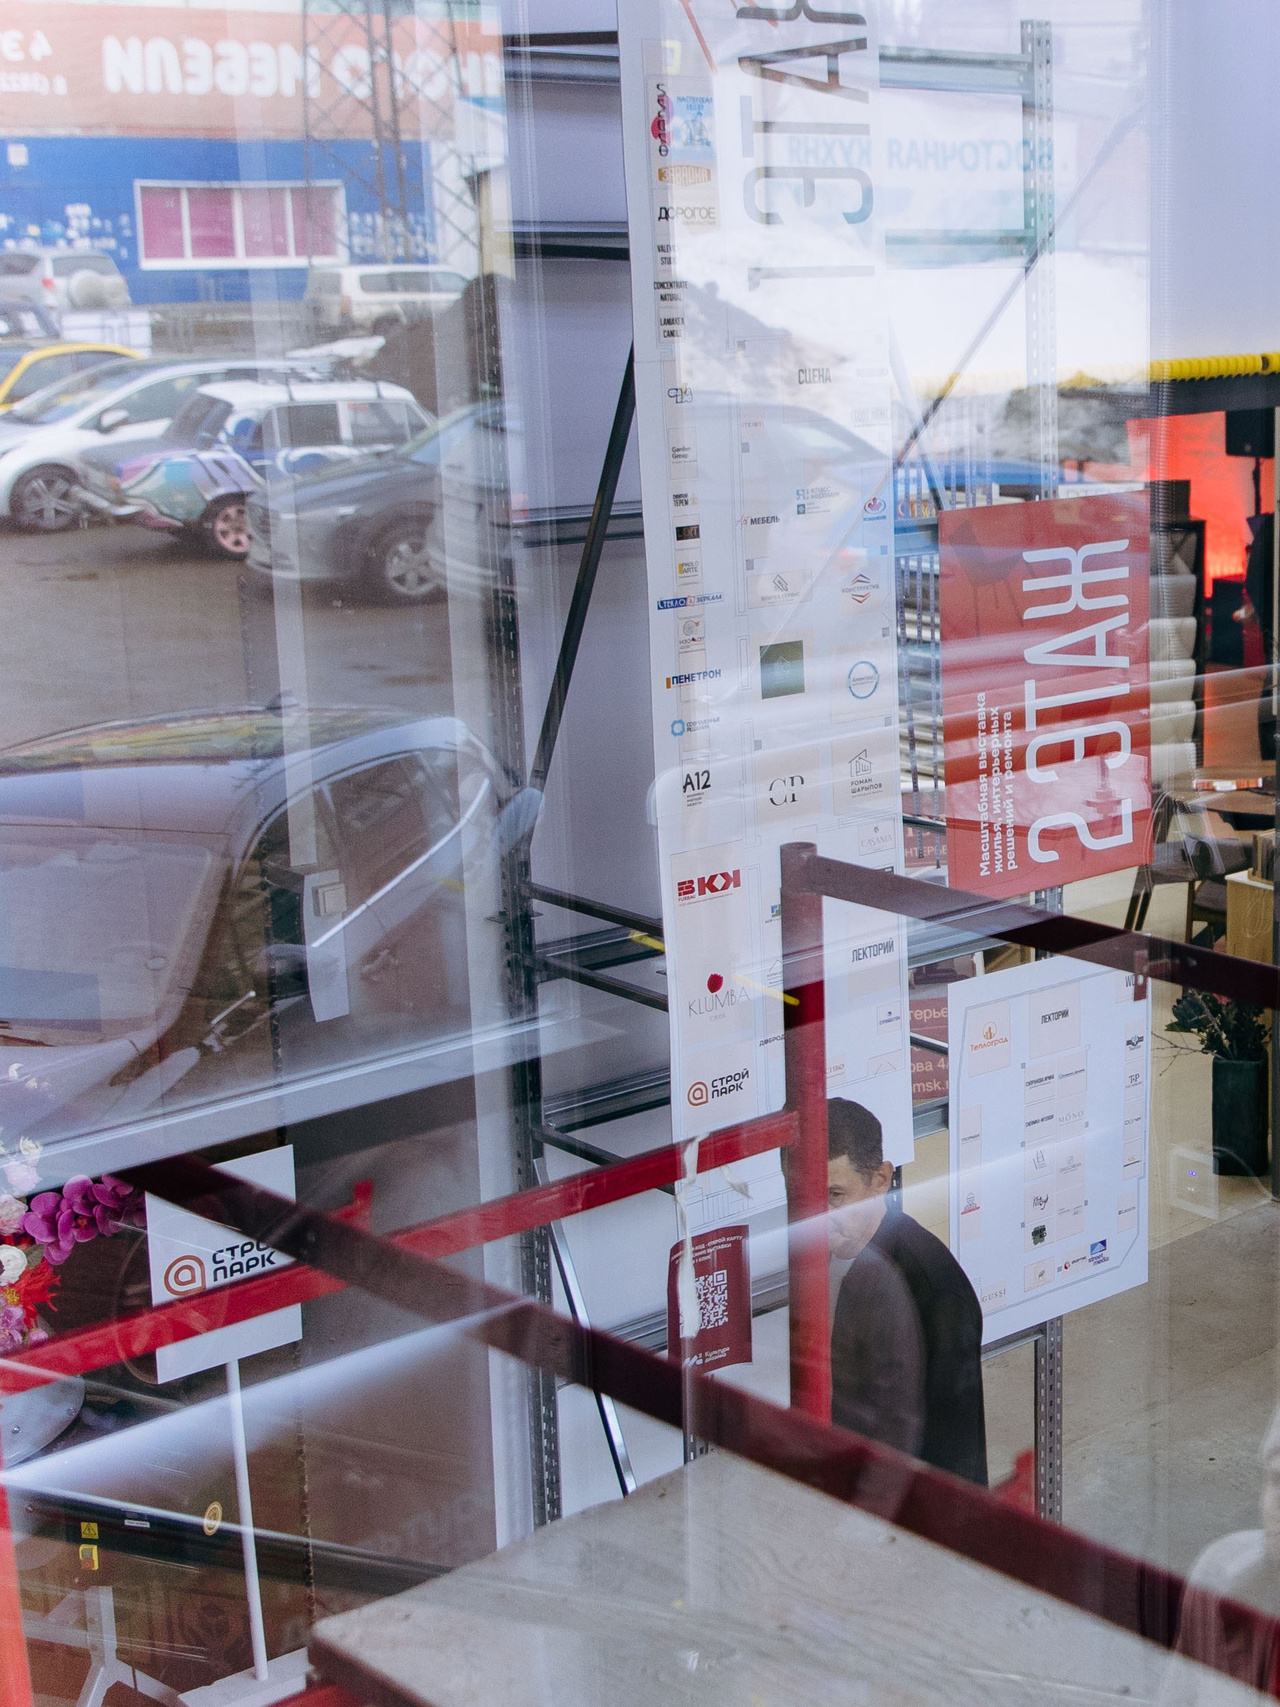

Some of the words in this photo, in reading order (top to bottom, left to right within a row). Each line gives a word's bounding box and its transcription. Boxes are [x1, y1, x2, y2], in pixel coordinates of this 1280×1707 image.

[658, 206, 716, 222] ДОРОГОЕ
[797, 367, 832, 385] СЦЕНА
[750, 515, 780, 526] МЕБЕЛЬ
[659, 597, 686, 609] СТЕКЛО
[1022, 539, 1131, 783] ЭТАЖ
[671, 669, 722, 686] ПЕНЕТРОН
[976, 691, 988, 770] выставка
[1001, 710, 1015, 780] ремонта
[988, 706, 1003, 815] интерьерных
[851, 778, 873, 786] РОМАН
[851, 783, 883, 794] ШАРЫПОВ
[1004, 784, 1014, 795] и
[978, 773, 991, 877] Масштабная
[1003, 798, 1018, 871] решений
[1026, 797, 1133, 863] 2
[992, 817, 1004, 874] жилья,
[851, 937, 895, 963] ЛЕКТОРИЙ
[687, 986, 750, 1018] KLUMBA
[1041, 1007, 1070, 1024] ЛЕКТОРИЙ
[970, 1036, 1009, 1052] Теплоград
[711, 1066, 750, 1088] СТРОЙ
[711, 1081, 744, 1099] ПАРК
[213, 1250, 277, 1282] ПАРК
[981, 1288, 1006, 1303] GUSSI
